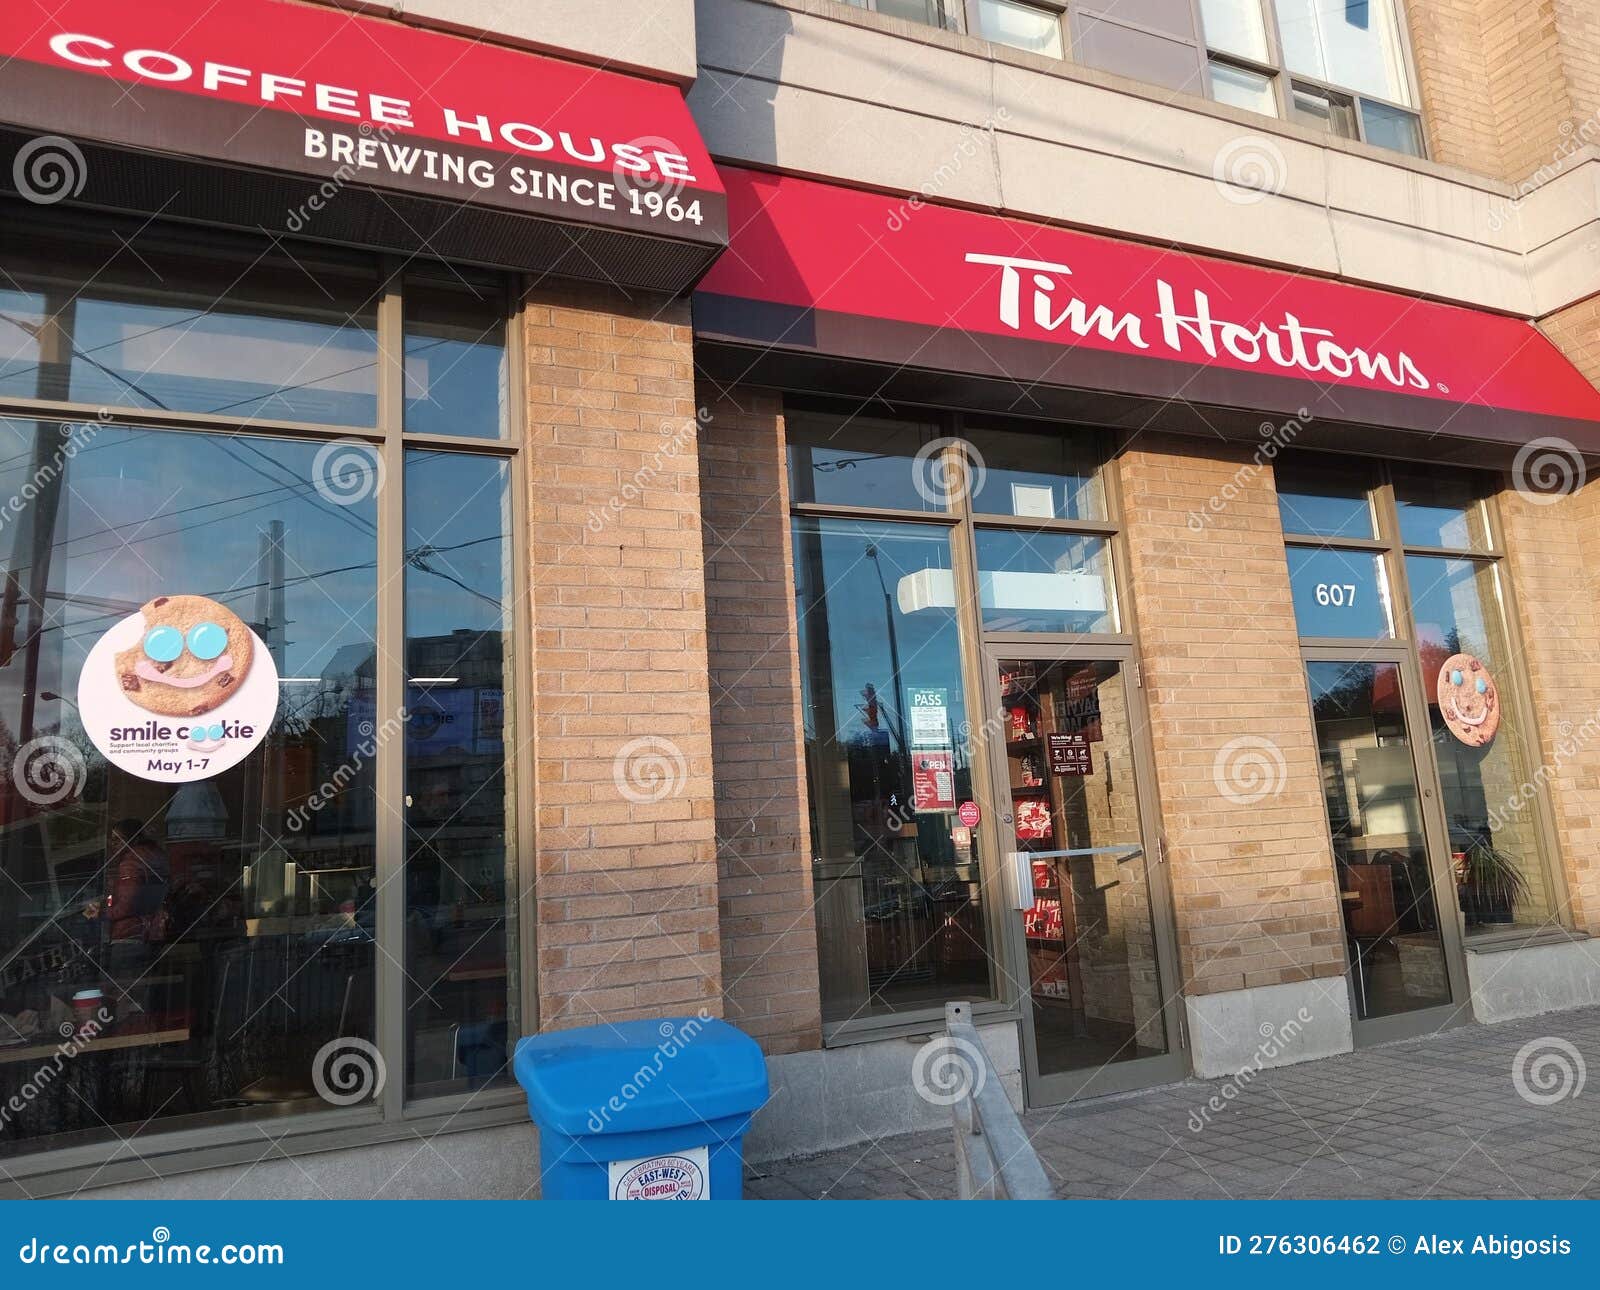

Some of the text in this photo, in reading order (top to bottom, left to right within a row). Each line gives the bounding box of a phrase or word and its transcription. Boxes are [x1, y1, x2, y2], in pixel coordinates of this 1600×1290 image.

[48, 33, 697, 182] COFFEE HOUSE
[303, 129, 703, 227] BREWING SINCE 1964
[964, 252, 1430, 390] Tim Hortons
[1315, 583, 1356, 607] 607
[914, 694, 942, 706] PASS
[109, 719, 254, 743] smile cookie
[147, 758, 210, 774] May 1-7
[638, 1168, 687, 1187] EAST-WEST
[644, 1182, 677, 1197] DISPOSAL
